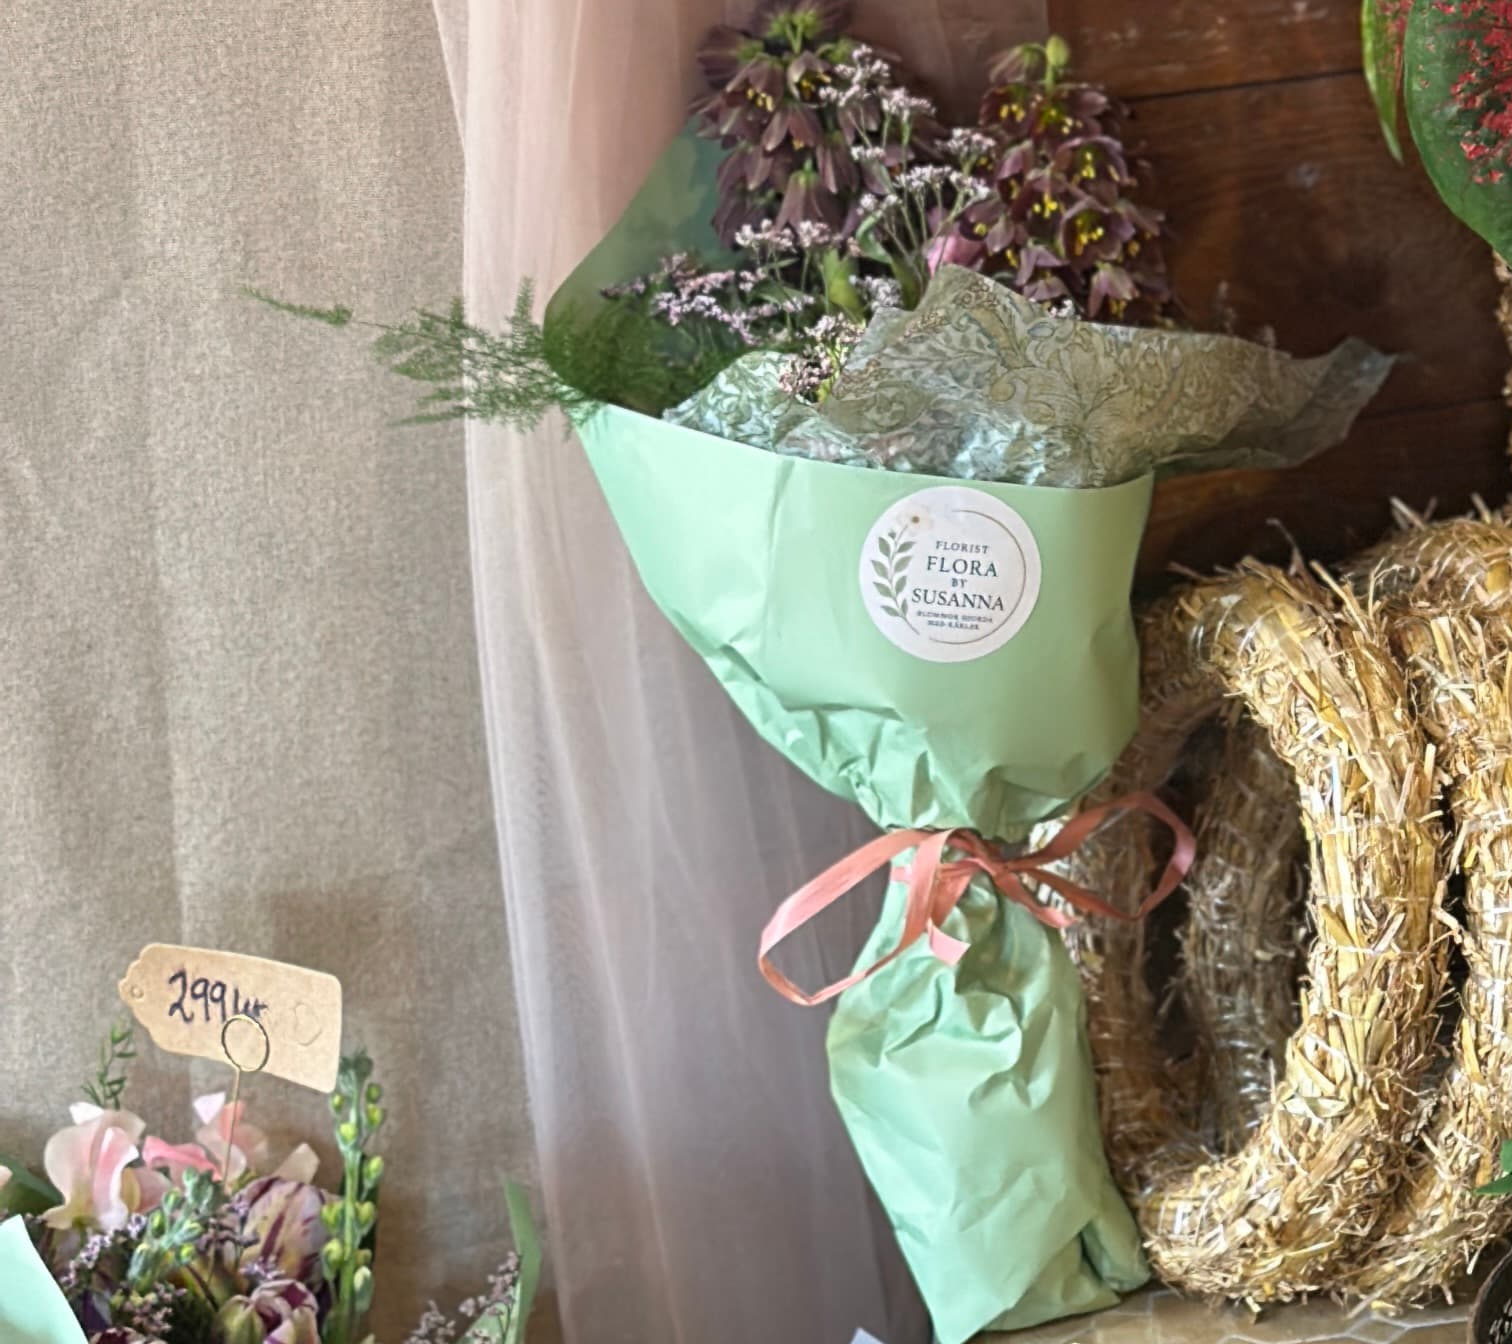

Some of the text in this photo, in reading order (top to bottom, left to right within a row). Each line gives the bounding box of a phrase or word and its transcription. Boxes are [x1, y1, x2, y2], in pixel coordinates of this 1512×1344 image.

[935, 540, 990, 555] FLORIST
[926, 555, 999, 578] FLORA
[951, 577, 968, 589] BY
[911, 587, 1005, 612] SUSANNA
[168, 968, 228, 1024] 299
